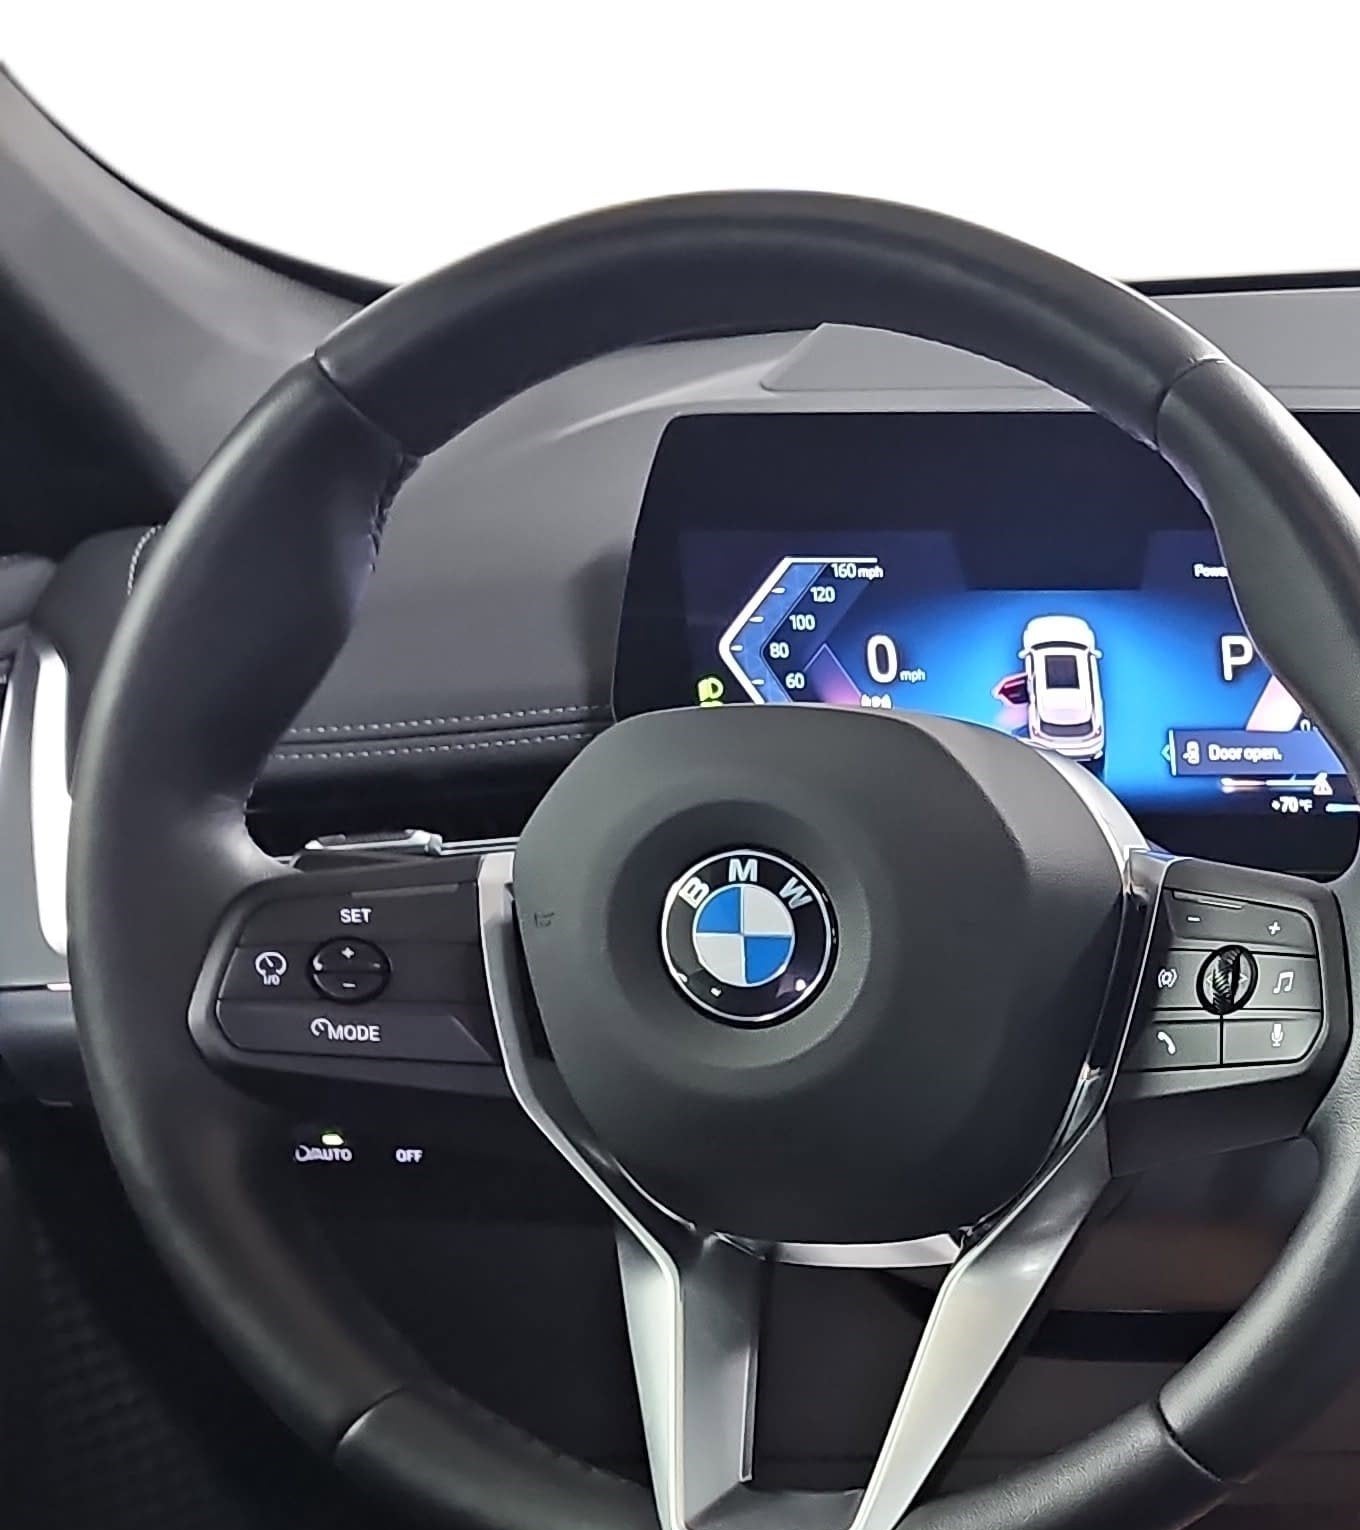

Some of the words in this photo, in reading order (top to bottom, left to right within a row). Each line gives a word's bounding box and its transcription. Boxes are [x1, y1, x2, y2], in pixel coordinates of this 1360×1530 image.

[831, 562, 856, 578] 160
[858, 565, 884, 580] mph
[810, 586, 836, 602] 120
[789, 614, 815, 630] 100
[770, 642, 789, 658] 80
[1220, 635, 1254, 681] P
[866, 634, 898, 684] 0
[786, 672, 805, 689] 60
[900, 668, 926, 683] mph
[1208, 744, 1243, 761] Door
[679, 858, 813, 909] BMW
[340, 908, 372, 924] SET
[327, 1024, 381, 1042] MODE
[395, 1148, 423, 1162] OFF
